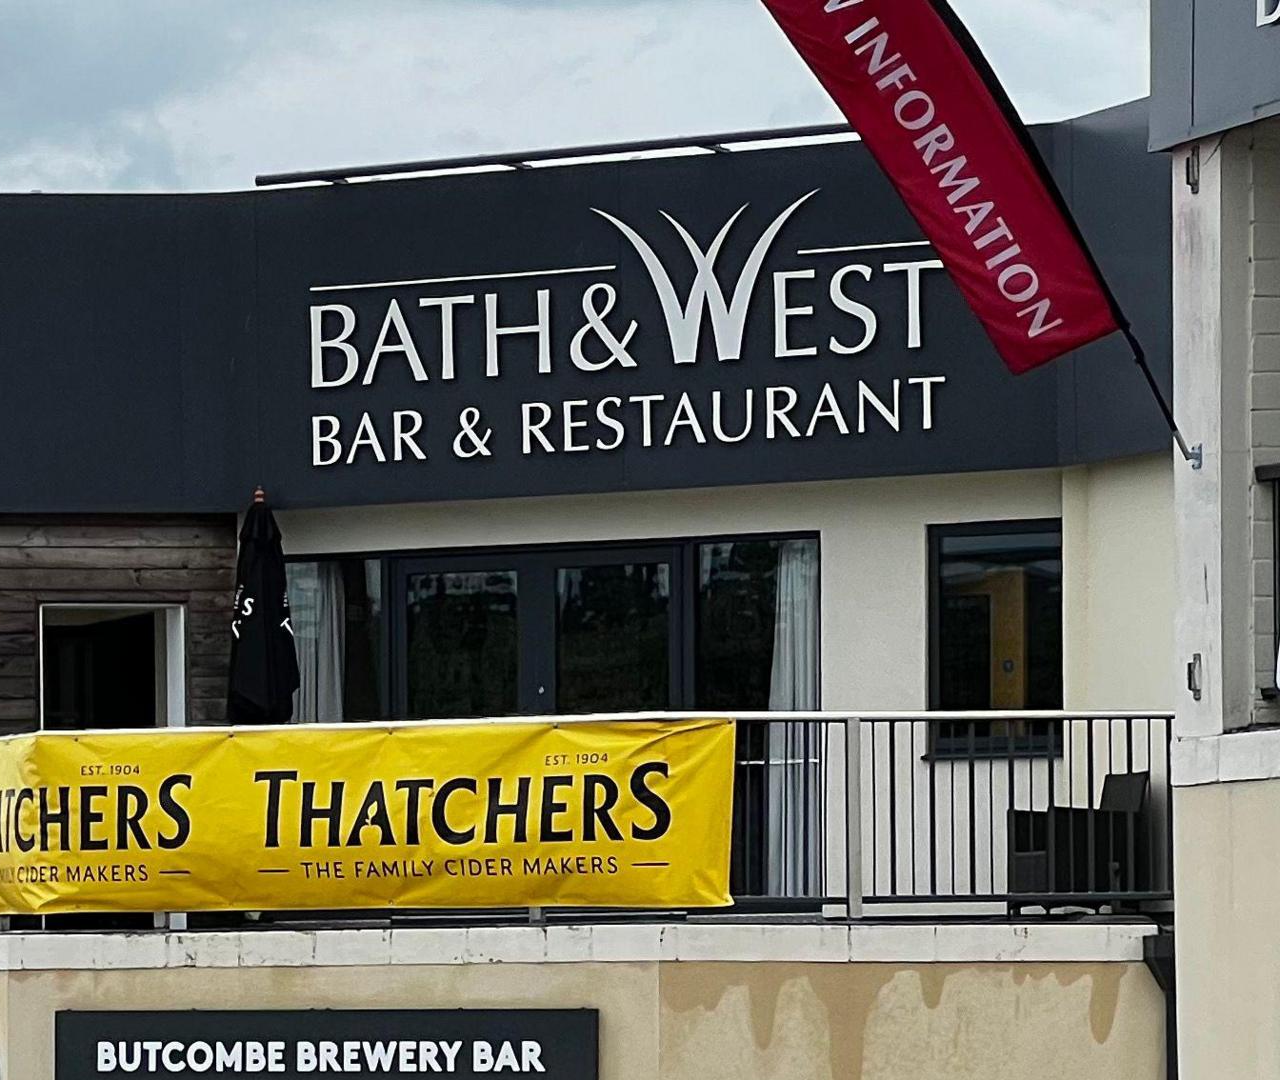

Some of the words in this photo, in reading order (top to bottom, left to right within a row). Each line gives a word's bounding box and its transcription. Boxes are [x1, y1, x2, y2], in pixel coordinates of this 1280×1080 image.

[844, 15, 1063, 339] INFORMATION
[310, 409, 427, 467] BAR
[452, 405, 493, 458] &
[521, 375, 946, 455] RESTAURANT
[110, 765, 140, 775] 1904
[576, 753, 609, 765] 1904
[254, 761, 672, 848] THATCHERS
[17, 865, 59, 884] CIDER
[66, 864, 149, 883] MAKERS
[301, 862, 344, 879] THE
[355, 859, 435, 878] FAMILY
[445, 857, 512, 876] CIDER
[524, 856, 619, 876] MAKERS
[96, 1041, 286, 1072] BUTCOMBE
[296, 1041, 463, 1072] BREWERY
[472, 1041, 546, 1072] BAR
